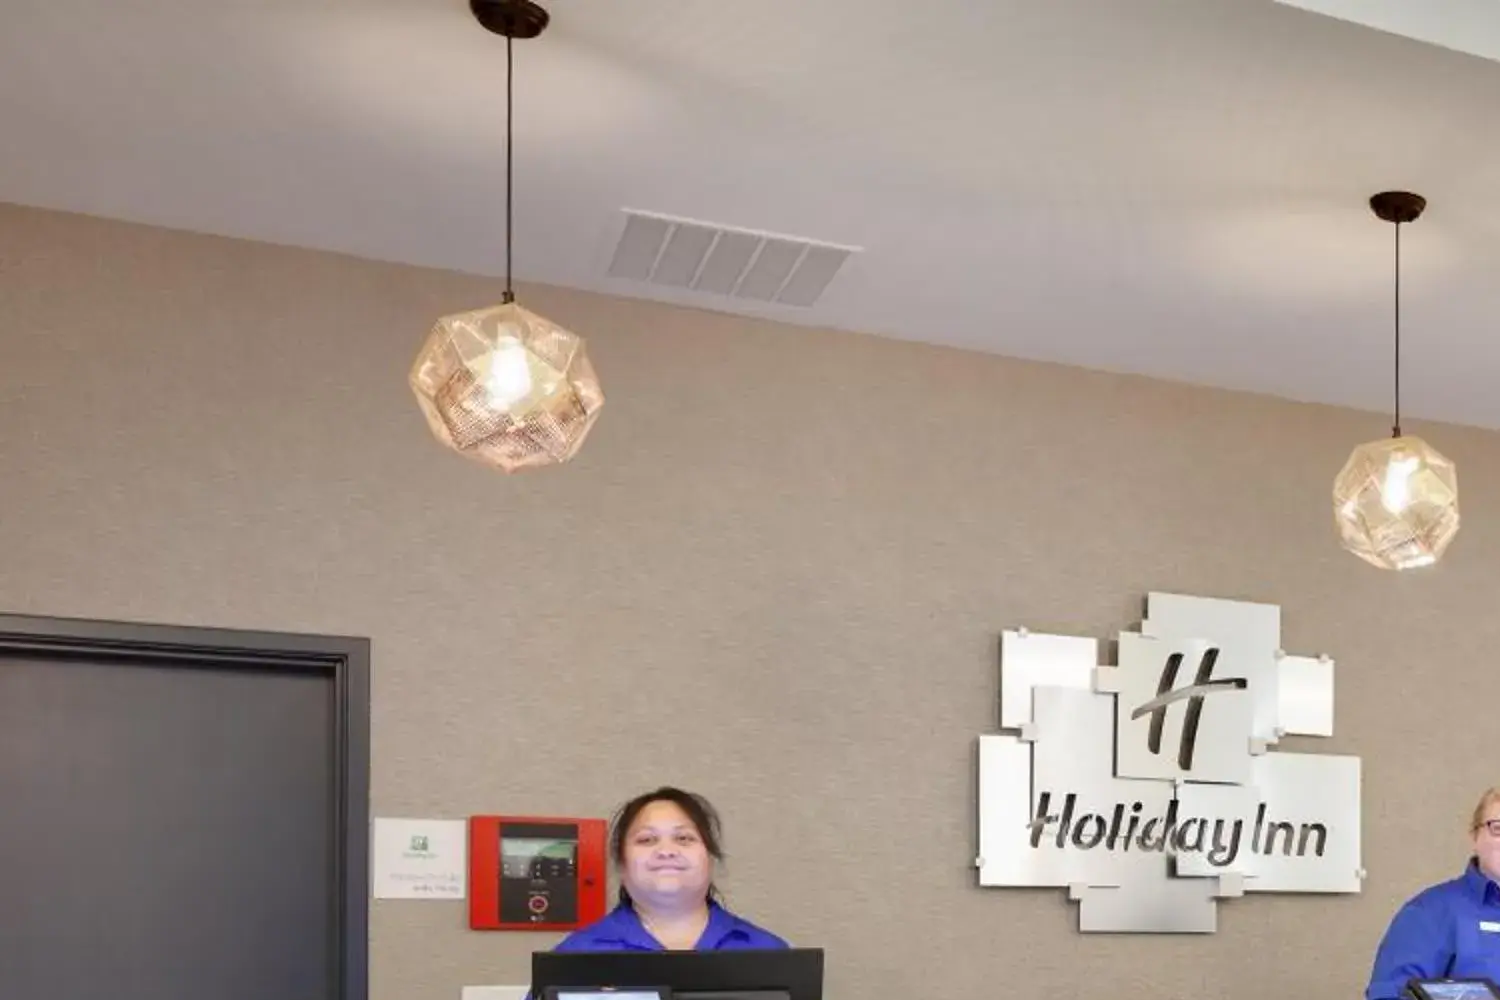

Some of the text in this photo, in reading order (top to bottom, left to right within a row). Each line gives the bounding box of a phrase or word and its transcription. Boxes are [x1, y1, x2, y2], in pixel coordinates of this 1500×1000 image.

[1131, 647, 1247, 770] H
[1027, 791, 1328, 867] Holiday Inn
